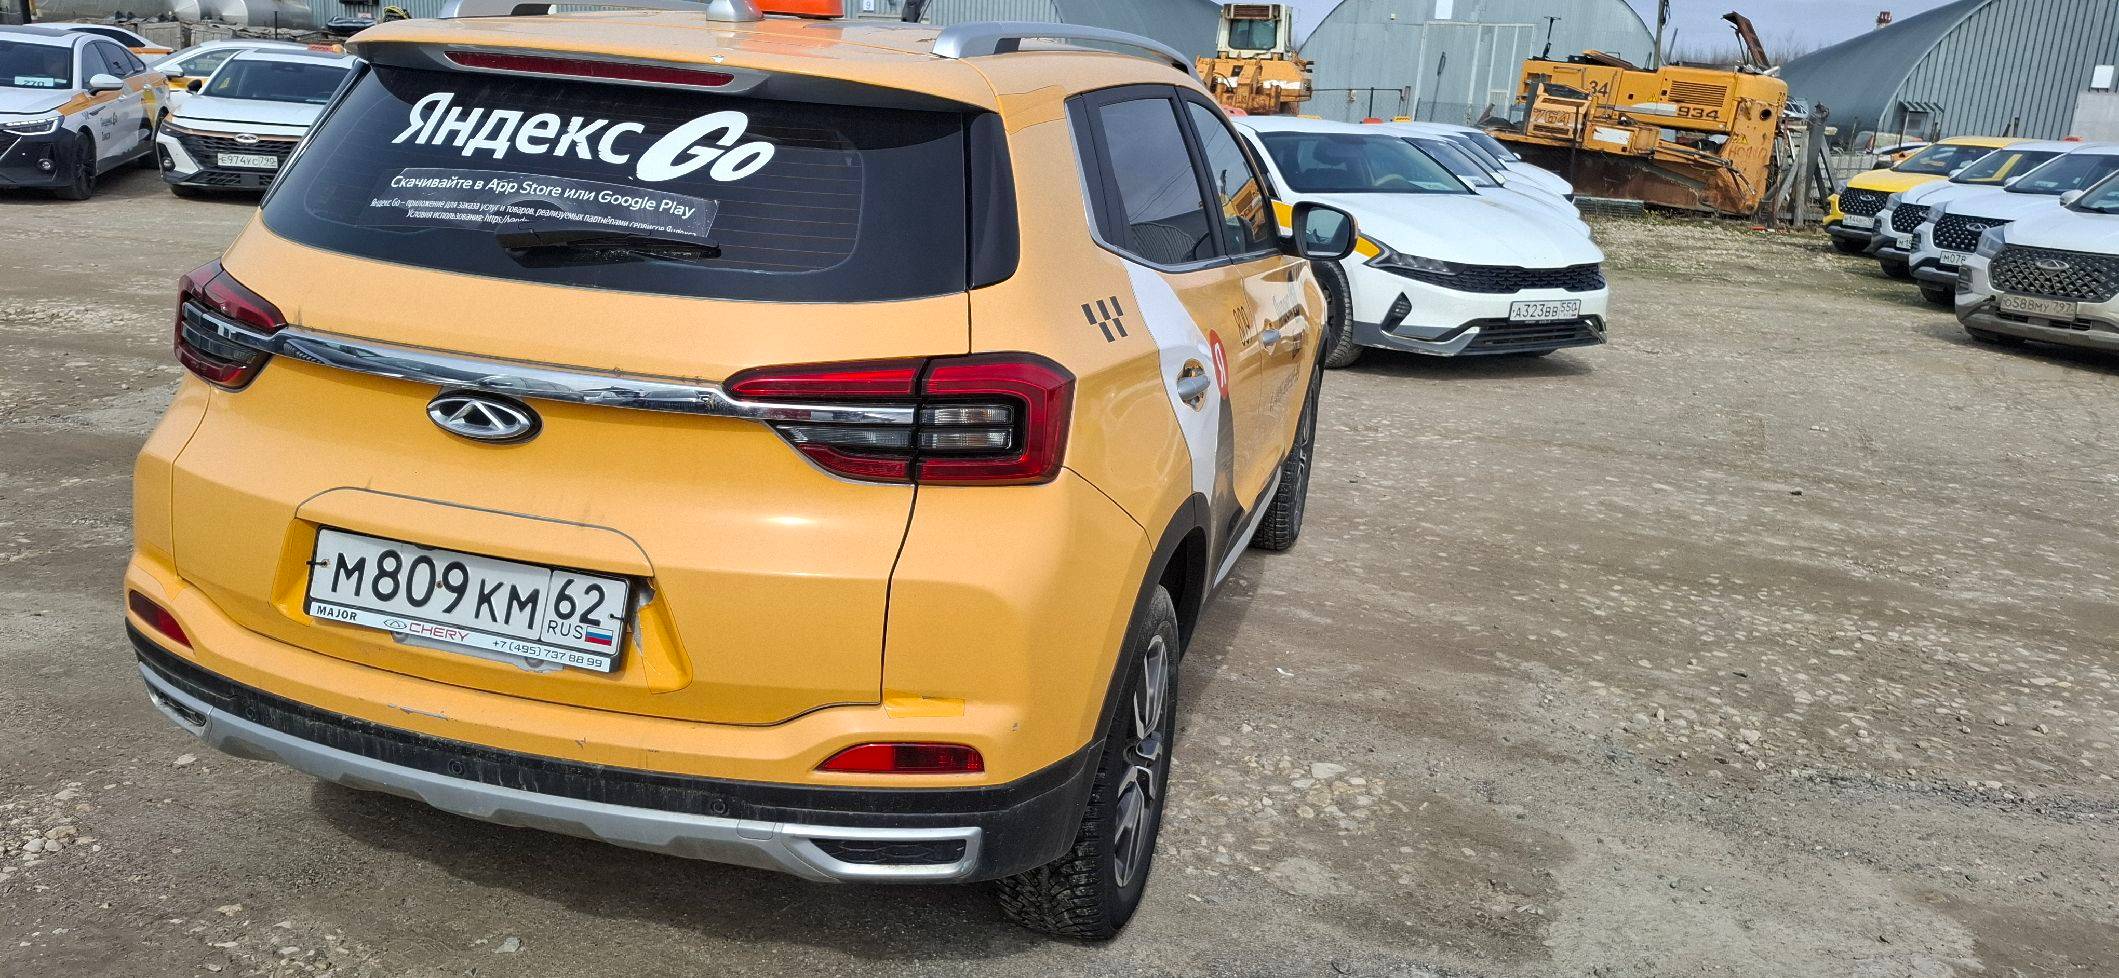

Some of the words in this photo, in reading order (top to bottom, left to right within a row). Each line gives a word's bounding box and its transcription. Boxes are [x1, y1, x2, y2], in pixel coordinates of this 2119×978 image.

[1677, 106, 1719, 119] 934
[392, 92, 645, 165] Яндекс
[636, 111, 775, 182] Go
[391, 175, 472, 190] Скачивайте
[474, 180, 484, 190] в
[486, 178, 518, 194] App
[520, 181, 562, 197] Store
[564, 188, 595, 201] или
[598, 190, 656, 211] Google
[658, 199, 696, 219] Play
[316, 605, 358, 621] MAJOR
[553, 578, 606, 627] 62
[409, 622, 470, 642] CHERY
[546, 619, 584, 640] RUS
[508, 641, 542, 656] (495)
[543, 648, 566, 660] 737
[568, 652, 584, 664] 88
[586, 657, 603, 668] 99
